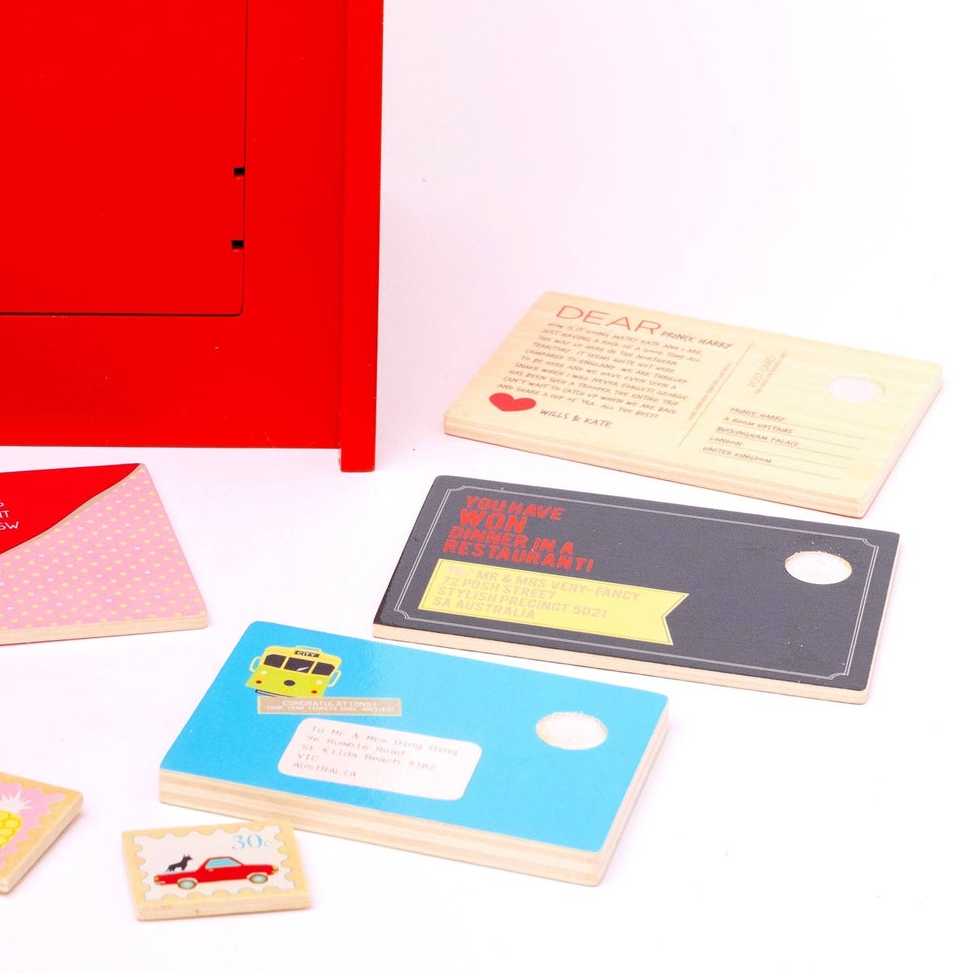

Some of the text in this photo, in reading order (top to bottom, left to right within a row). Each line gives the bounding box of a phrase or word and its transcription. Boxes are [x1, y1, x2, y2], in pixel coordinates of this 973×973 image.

[555, 304, 733, 349] DEAR PRINCE HARRY
[582, 417, 613, 428] KATE
[459, 508, 528, 533] WON
[465, 495, 565, 521] YOU HAVE
[448, 525, 575, 555] DINNER IN A
[443, 539, 594, 571] RESTAURANT!
[441, 576, 557, 600] 72 POSH STREET
[475, 570, 499, 581] MR
[515, 575, 547, 588] MRS
[550, 580, 641, 601] VERY-FANCY
[432, 596, 536, 619] SA AUSTRALIA
[436, 585, 498, 602] STYLISH
[499, 594, 568, 612] PRECINCT
[295, 650, 317, 658] CITY
[230, 834, 273, 850] 30c
